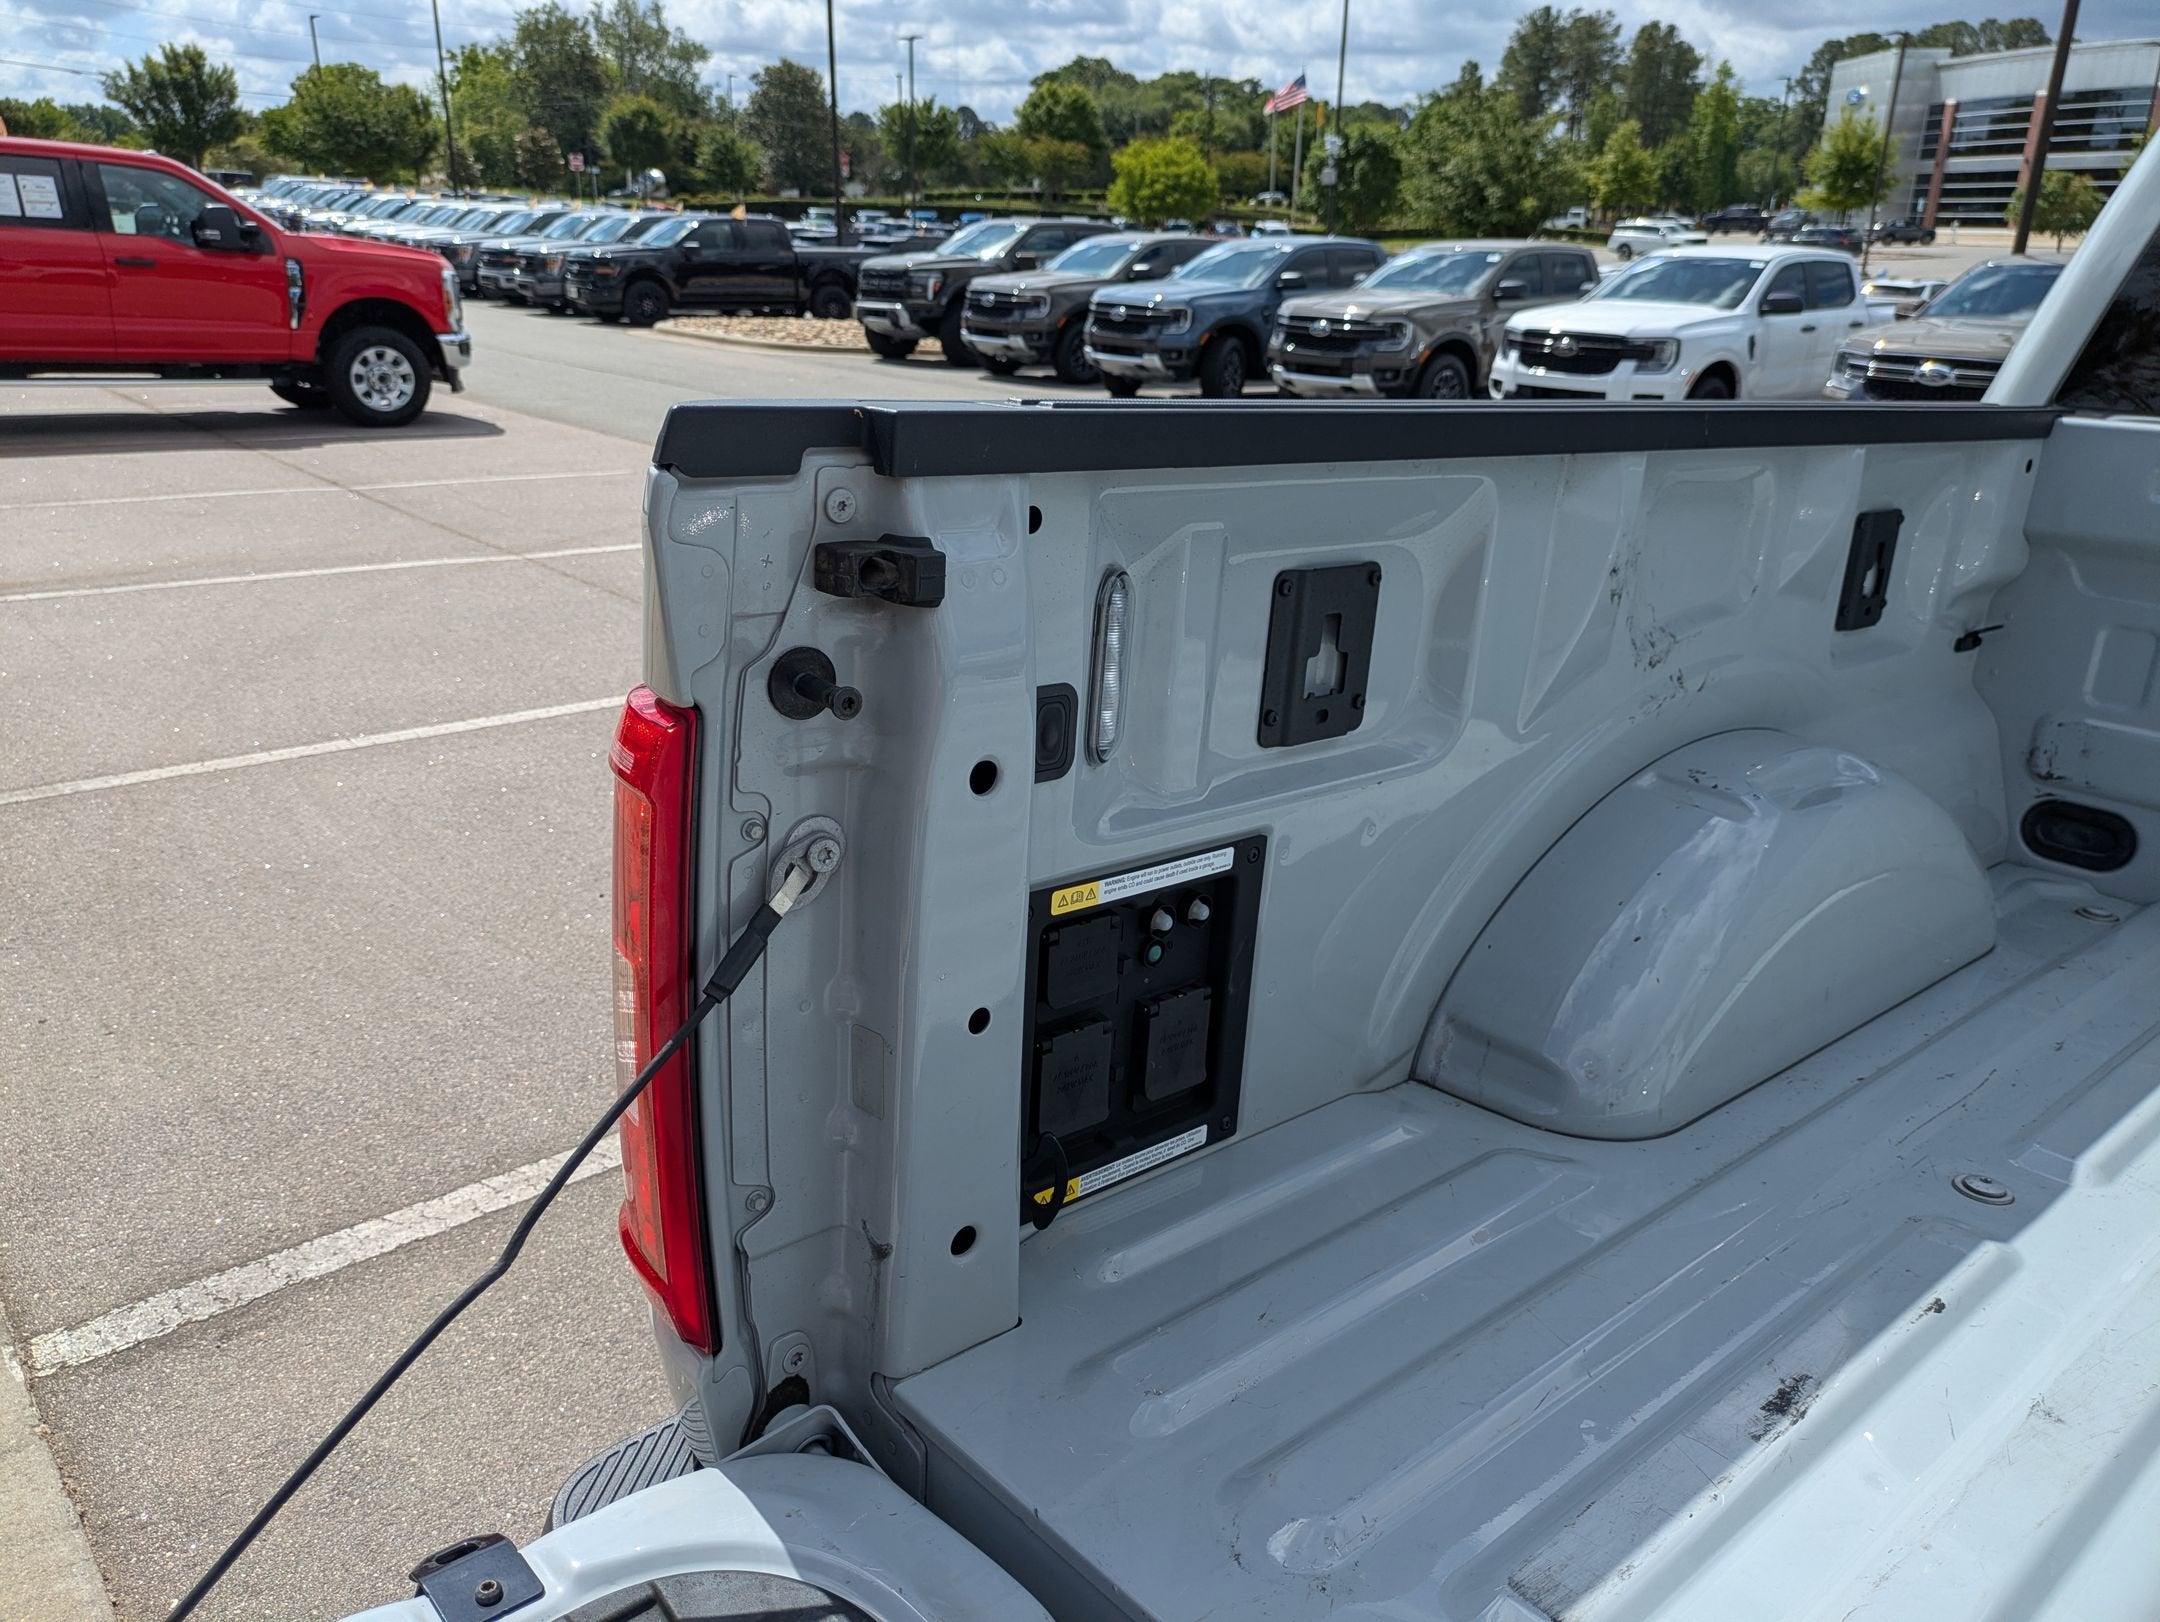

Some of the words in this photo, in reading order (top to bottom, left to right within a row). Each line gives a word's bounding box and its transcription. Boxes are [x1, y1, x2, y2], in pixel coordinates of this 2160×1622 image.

[1105, 876, 1126, 887] WARNING:
[1127, 873, 1140, 882] Engine
[1104, 887, 1116, 895] engine
